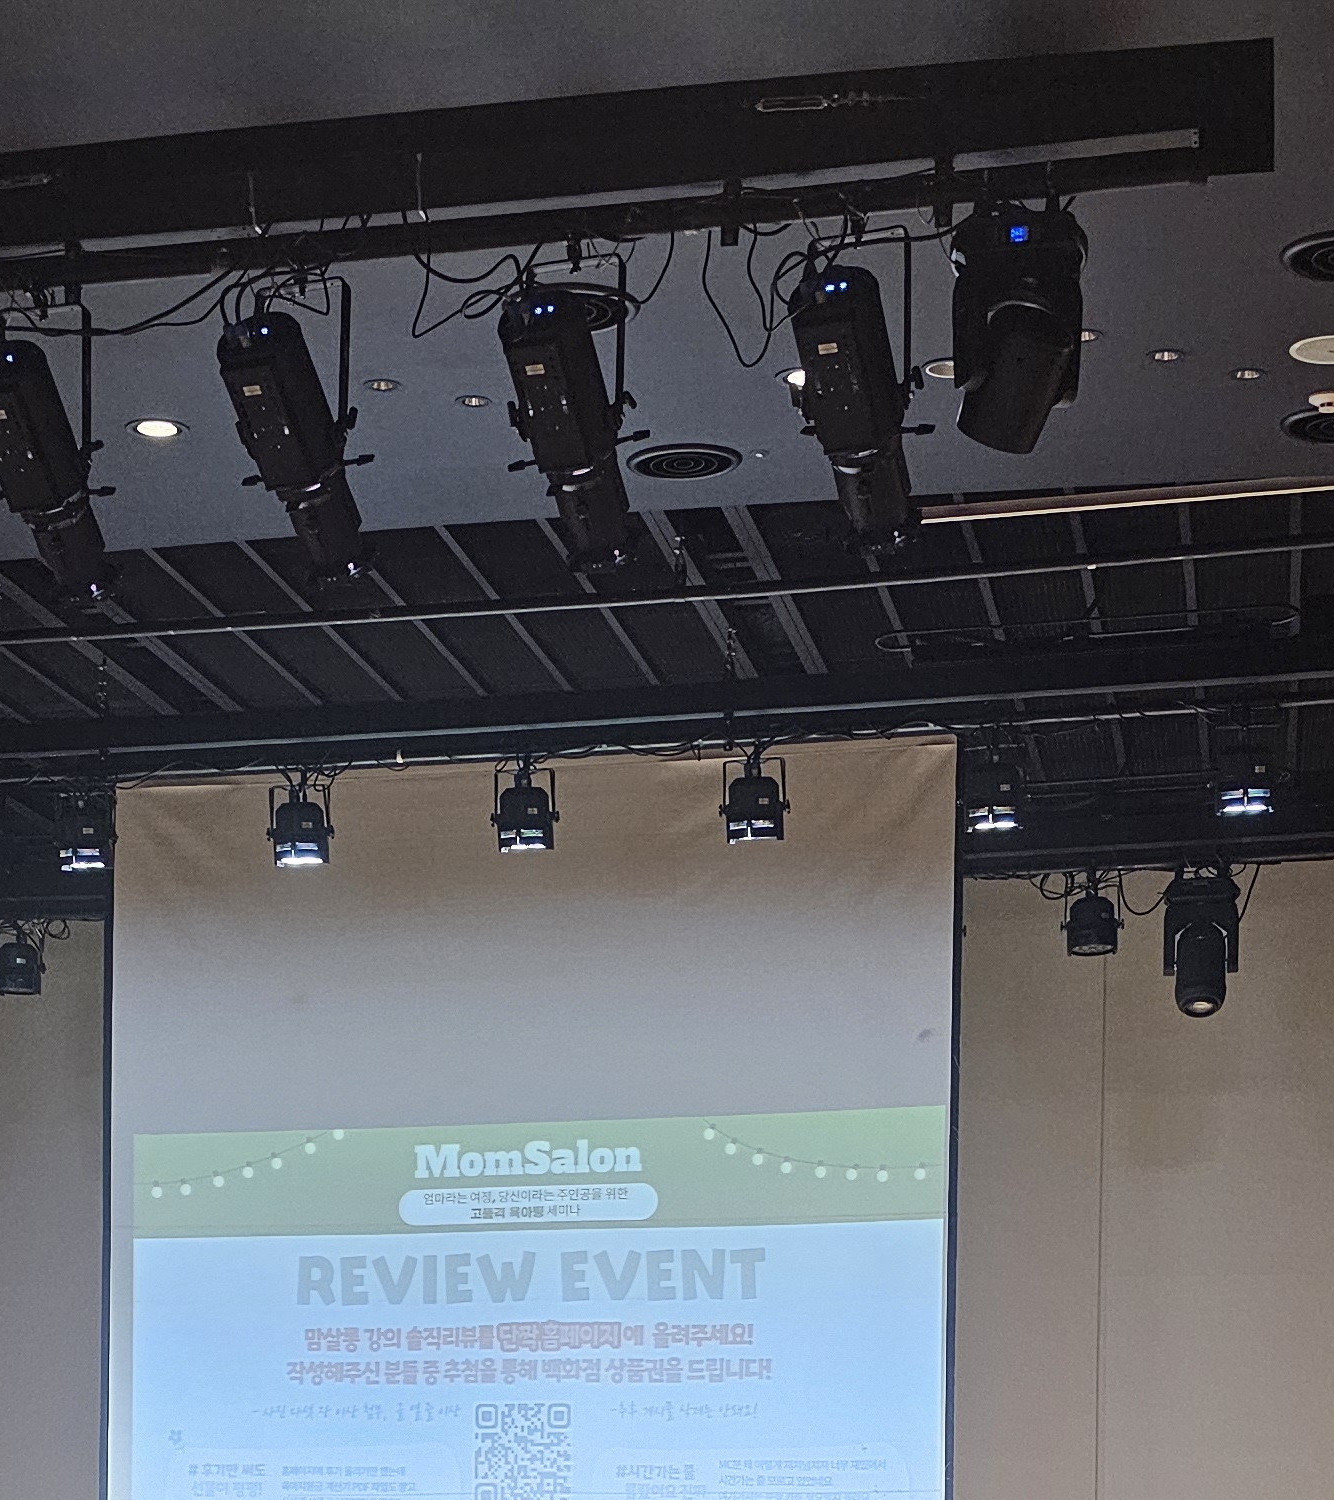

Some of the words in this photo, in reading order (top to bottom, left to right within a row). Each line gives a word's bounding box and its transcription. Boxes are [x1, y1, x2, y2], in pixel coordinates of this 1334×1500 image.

[414, 1139, 642, 1179] MomSalon
[423, 1192, 468, 1206] 엄마라는
[470, 1191, 497, 1205] 여정,
[498, 1189, 555, 1204] 당신이라는
[557, 1187, 603, 1201] 주인공을
[605, 1186, 629, 1201] 위한
[547, 1203, 581, 1217] 세미나
[297, 1251, 536, 1306] REVIEW
[560, 1247, 767, 1302] EVENT
[305, 1326, 360, 1352] 맘살롱
[363, 1326, 402, 1351] 강의
[405, 1324, 493, 1351] 솔직리뷰를
[652, 1321, 754, 1350] 올려주세요!
[286, 1360, 380, 1386] 작성해주신
[384, 1359, 419, 1385] 분들
[422, 1359, 440, 1386] 중
[443, 1357, 497, 1385] 추첨을
[500, 1357, 538, 1385] 통해
[541, 1358, 601, 1384] 백화점
[605, 1356, 683, 1384] 상품권을
[687, 1357, 772, 1384] 드립니다!
